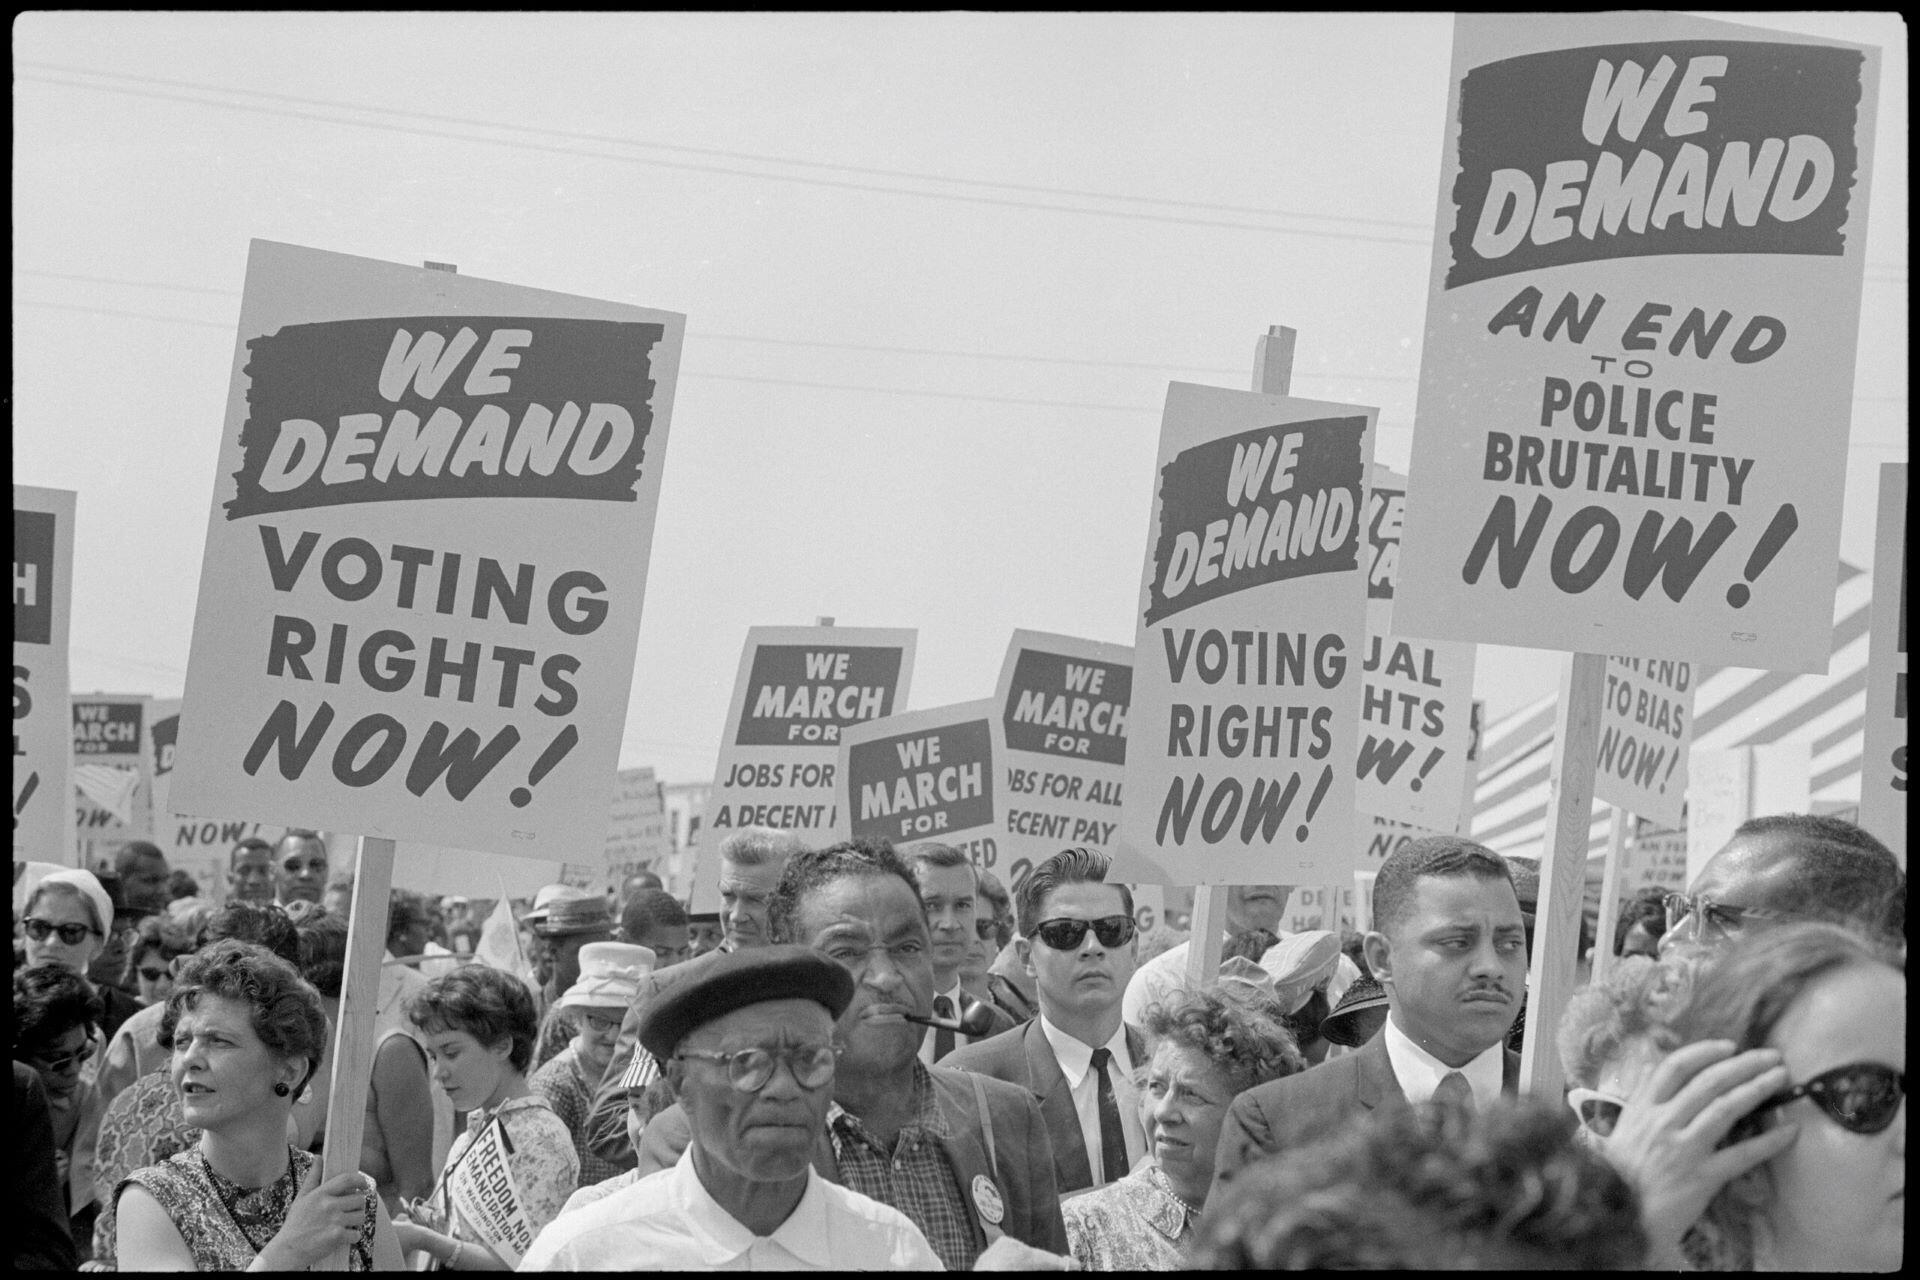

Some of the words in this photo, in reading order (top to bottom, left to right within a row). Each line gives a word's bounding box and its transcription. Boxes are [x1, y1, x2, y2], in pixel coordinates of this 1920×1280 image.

[1582, 54, 1728, 146] WE
[1471, 134, 1835, 259] DEMAND
[1487, 286, 1606, 344] AN
[1621, 302, 1787, 364] END
[378, 326, 533, 402] WE
[1591, 355, 1653, 378] TO
[1540, 376, 1718, 445] POLICE
[258, 400, 635, 493] DEMAND
[1227, 432, 1304, 507] WE
[1483, 431, 1755, 506] BRUTALITY
[1162, 486, 1353, 599] DEMAND
[1462, 493, 1799, 609] NOW!
[258, 524, 609, 635] VOTING
[266, 614, 582, 717] RIGHTS
[805, 652, 850, 681] WE
[1065, 663, 1106, 696] WE
[1162, 628, 1347, 690] VOTING
[752, 684, 885, 720] MARCH
[788, 724, 839, 741] FOR
[1013, 689, 1130, 738] MARCH
[1167, 703, 1333, 761] RIGHTS
[1362, 683, 1446, 738] HTS
[1607, 674, 1632, 717] TO
[1635, 688, 1684, 740] BIAS
[243, 699, 579, 808] NOW!
[724, 763, 785, 788] JOBS
[790, 764, 836, 788] FOR
[896, 736, 941, 770] WE
[1044, 732, 1090, 755] FOR
[1356, 734, 1446, 793] W!
[1597, 725, 1679, 795] NOW!
[713, 805, 732, 828] A
[737, 804, 826, 829] DECENT
[860, 762, 983, 821] MARCH
[1040, 772, 1083, 801] FOR
[1085, 779, 1123, 807] ALL
[1156, 763, 1334, 847] NOW!
[901, 811, 948, 836] FOR
[1072, 816, 1117, 846] PAY
[466, 1148, 515, 1242] EMANCIPATION
[478, 1126, 518, 1217] FREEDOM
